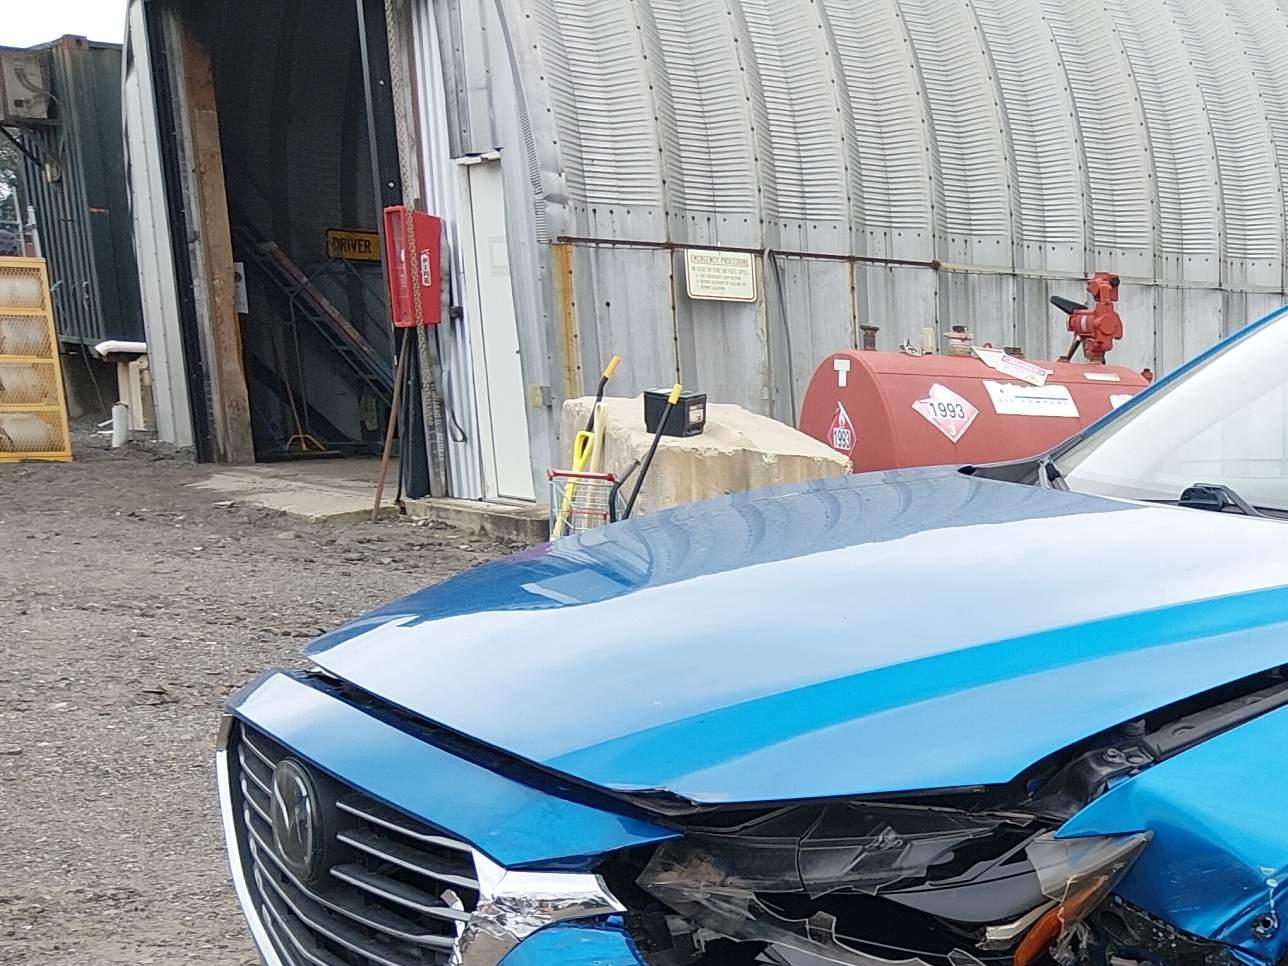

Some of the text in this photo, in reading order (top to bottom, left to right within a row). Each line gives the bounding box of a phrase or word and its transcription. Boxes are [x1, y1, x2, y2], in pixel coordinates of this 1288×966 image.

[332, 236, 372, 254] DRIVER
[690, 255, 720, 265] EMERGENCY
[422, 257, 430, 284] FIRE
[929, 402, 965, 419] 1993
[834, 429, 850, 449] 1993
